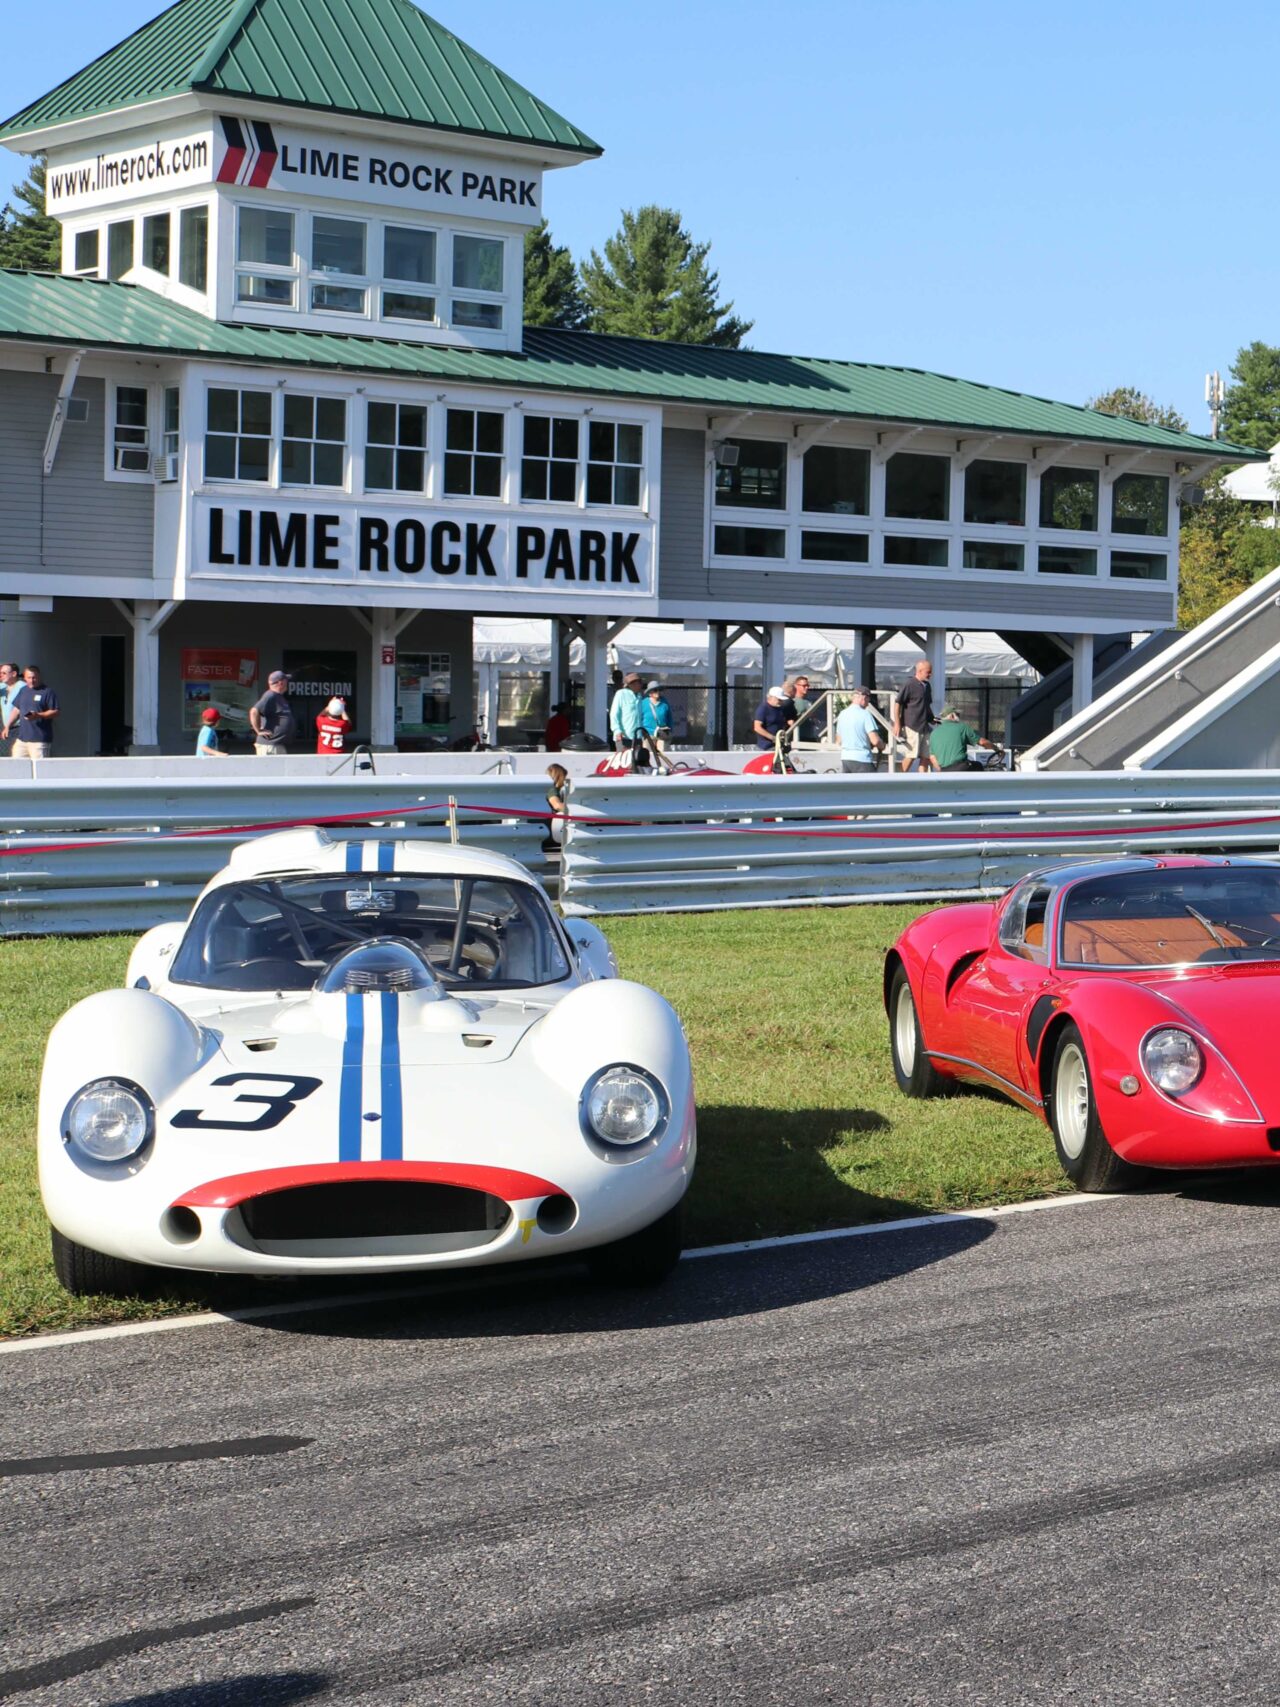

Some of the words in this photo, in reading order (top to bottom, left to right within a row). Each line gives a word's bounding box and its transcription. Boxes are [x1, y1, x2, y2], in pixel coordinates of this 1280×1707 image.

[51, 140, 207, 199] www.limerock.com
[281, 145, 359, 181] LIME
[369, 158, 452, 195] ROCK
[462, 172, 537, 207] PARK
[209, 507, 340, 569] LIME
[359, 517, 497, 576] ROCK
[516, 526, 641, 583] PARK
[187, 665, 232, 675] FASTER
[288, 682, 352, 696] PRECISION
[170, 1072, 323, 1131] 3
